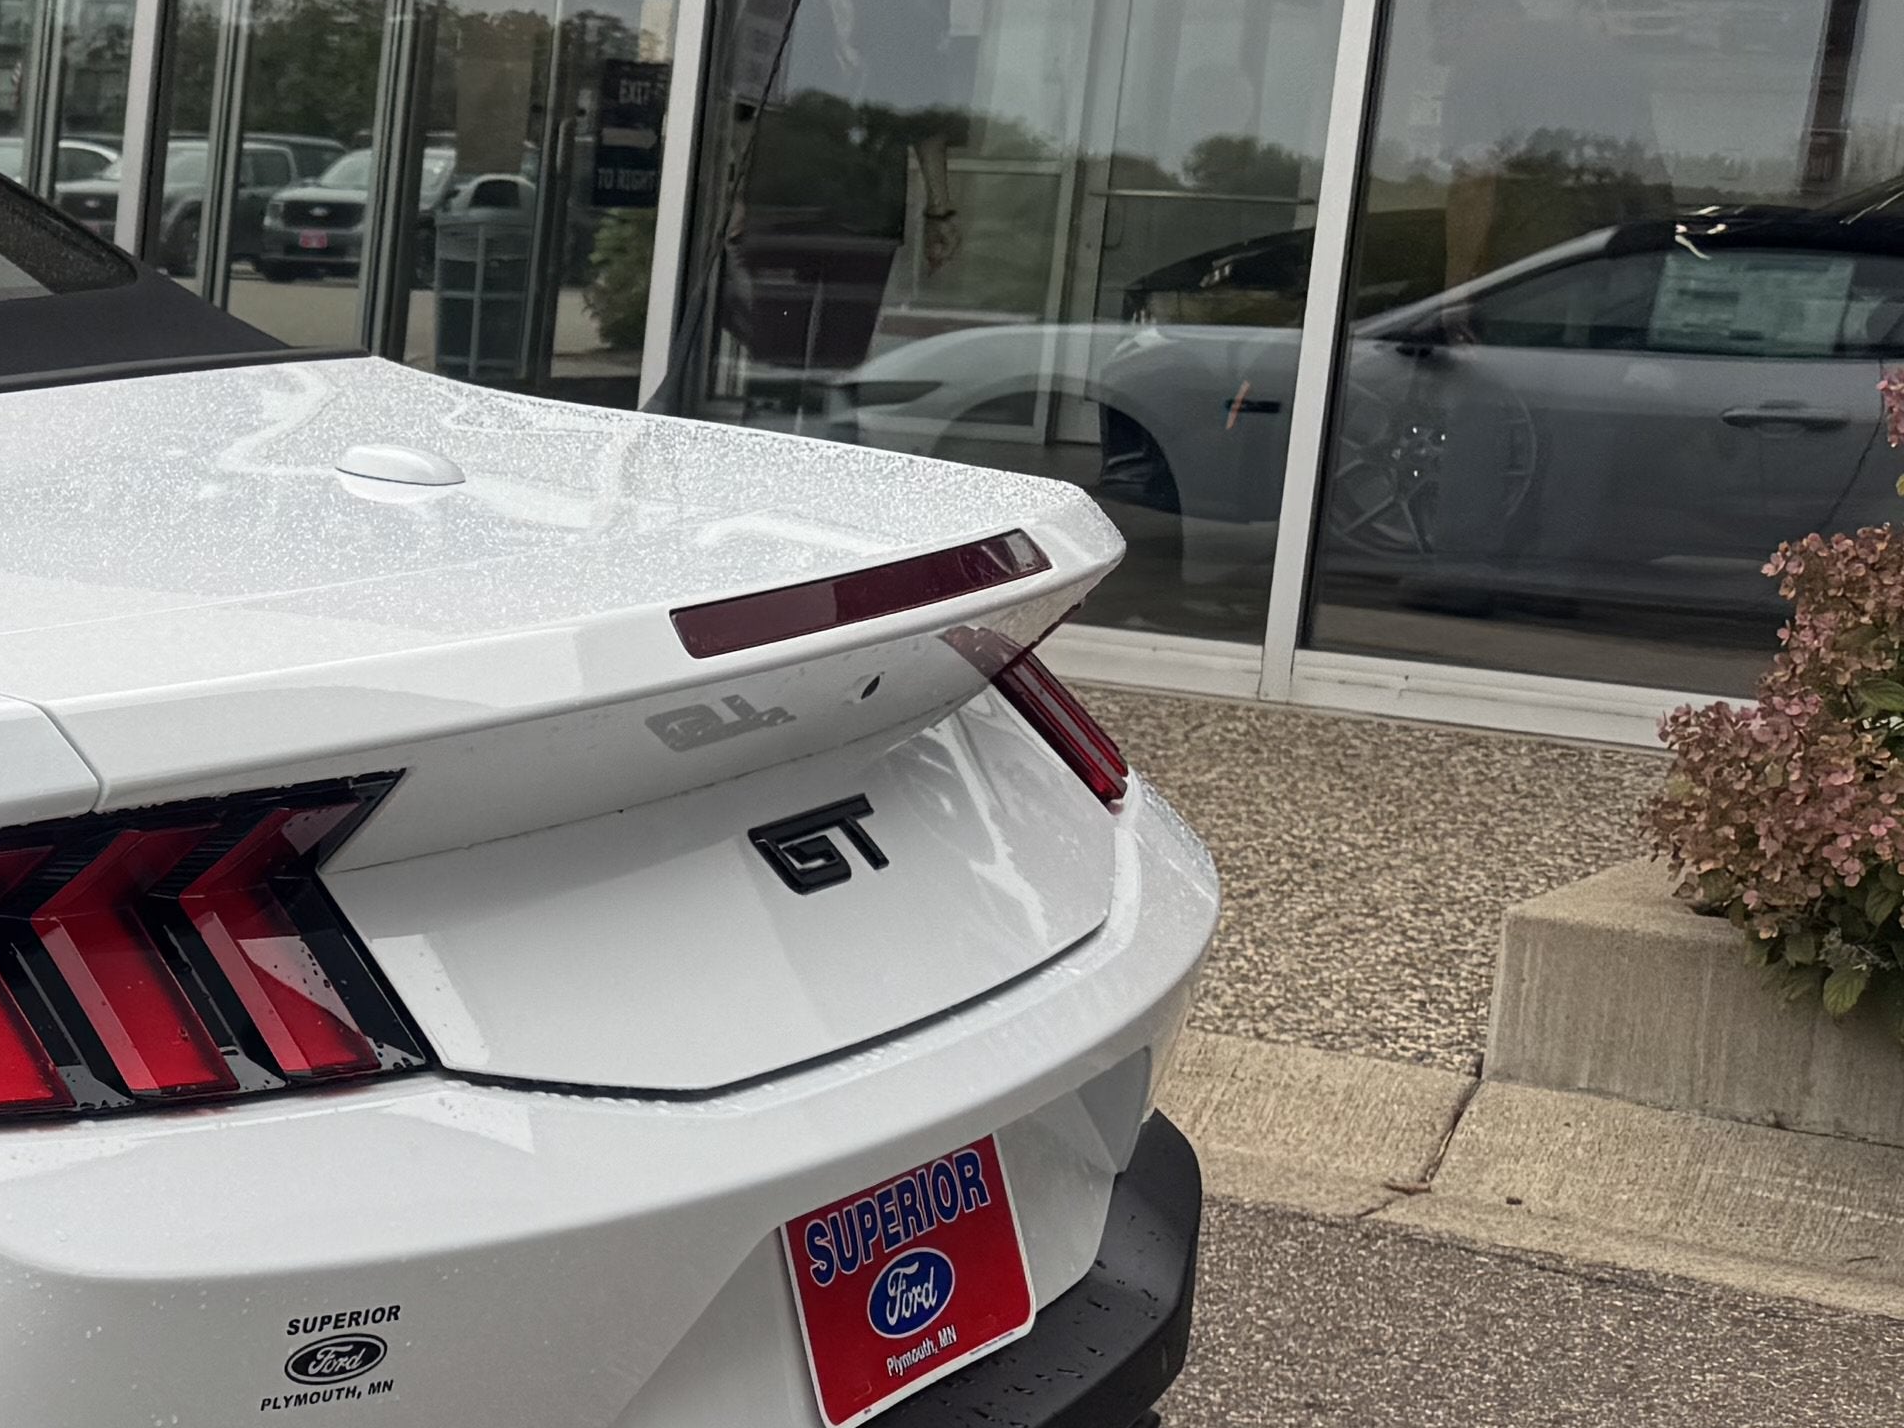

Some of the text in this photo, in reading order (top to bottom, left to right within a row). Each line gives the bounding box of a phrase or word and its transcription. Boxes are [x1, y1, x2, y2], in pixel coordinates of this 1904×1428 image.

[747, 792, 890, 896] GT
[803, 1148, 991, 1287] SUPERIOR
[286, 1304, 401, 1336] SUPERIOR
[886, 1261, 938, 1326] Ford
[307, 1344, 367, 1375] Ford
[886, 1336, 939, 1377] Plymouth,
[937, 1324, 957, 1349] MN
[260, 1379, 394, 1412] PLYMOUTH, MN
